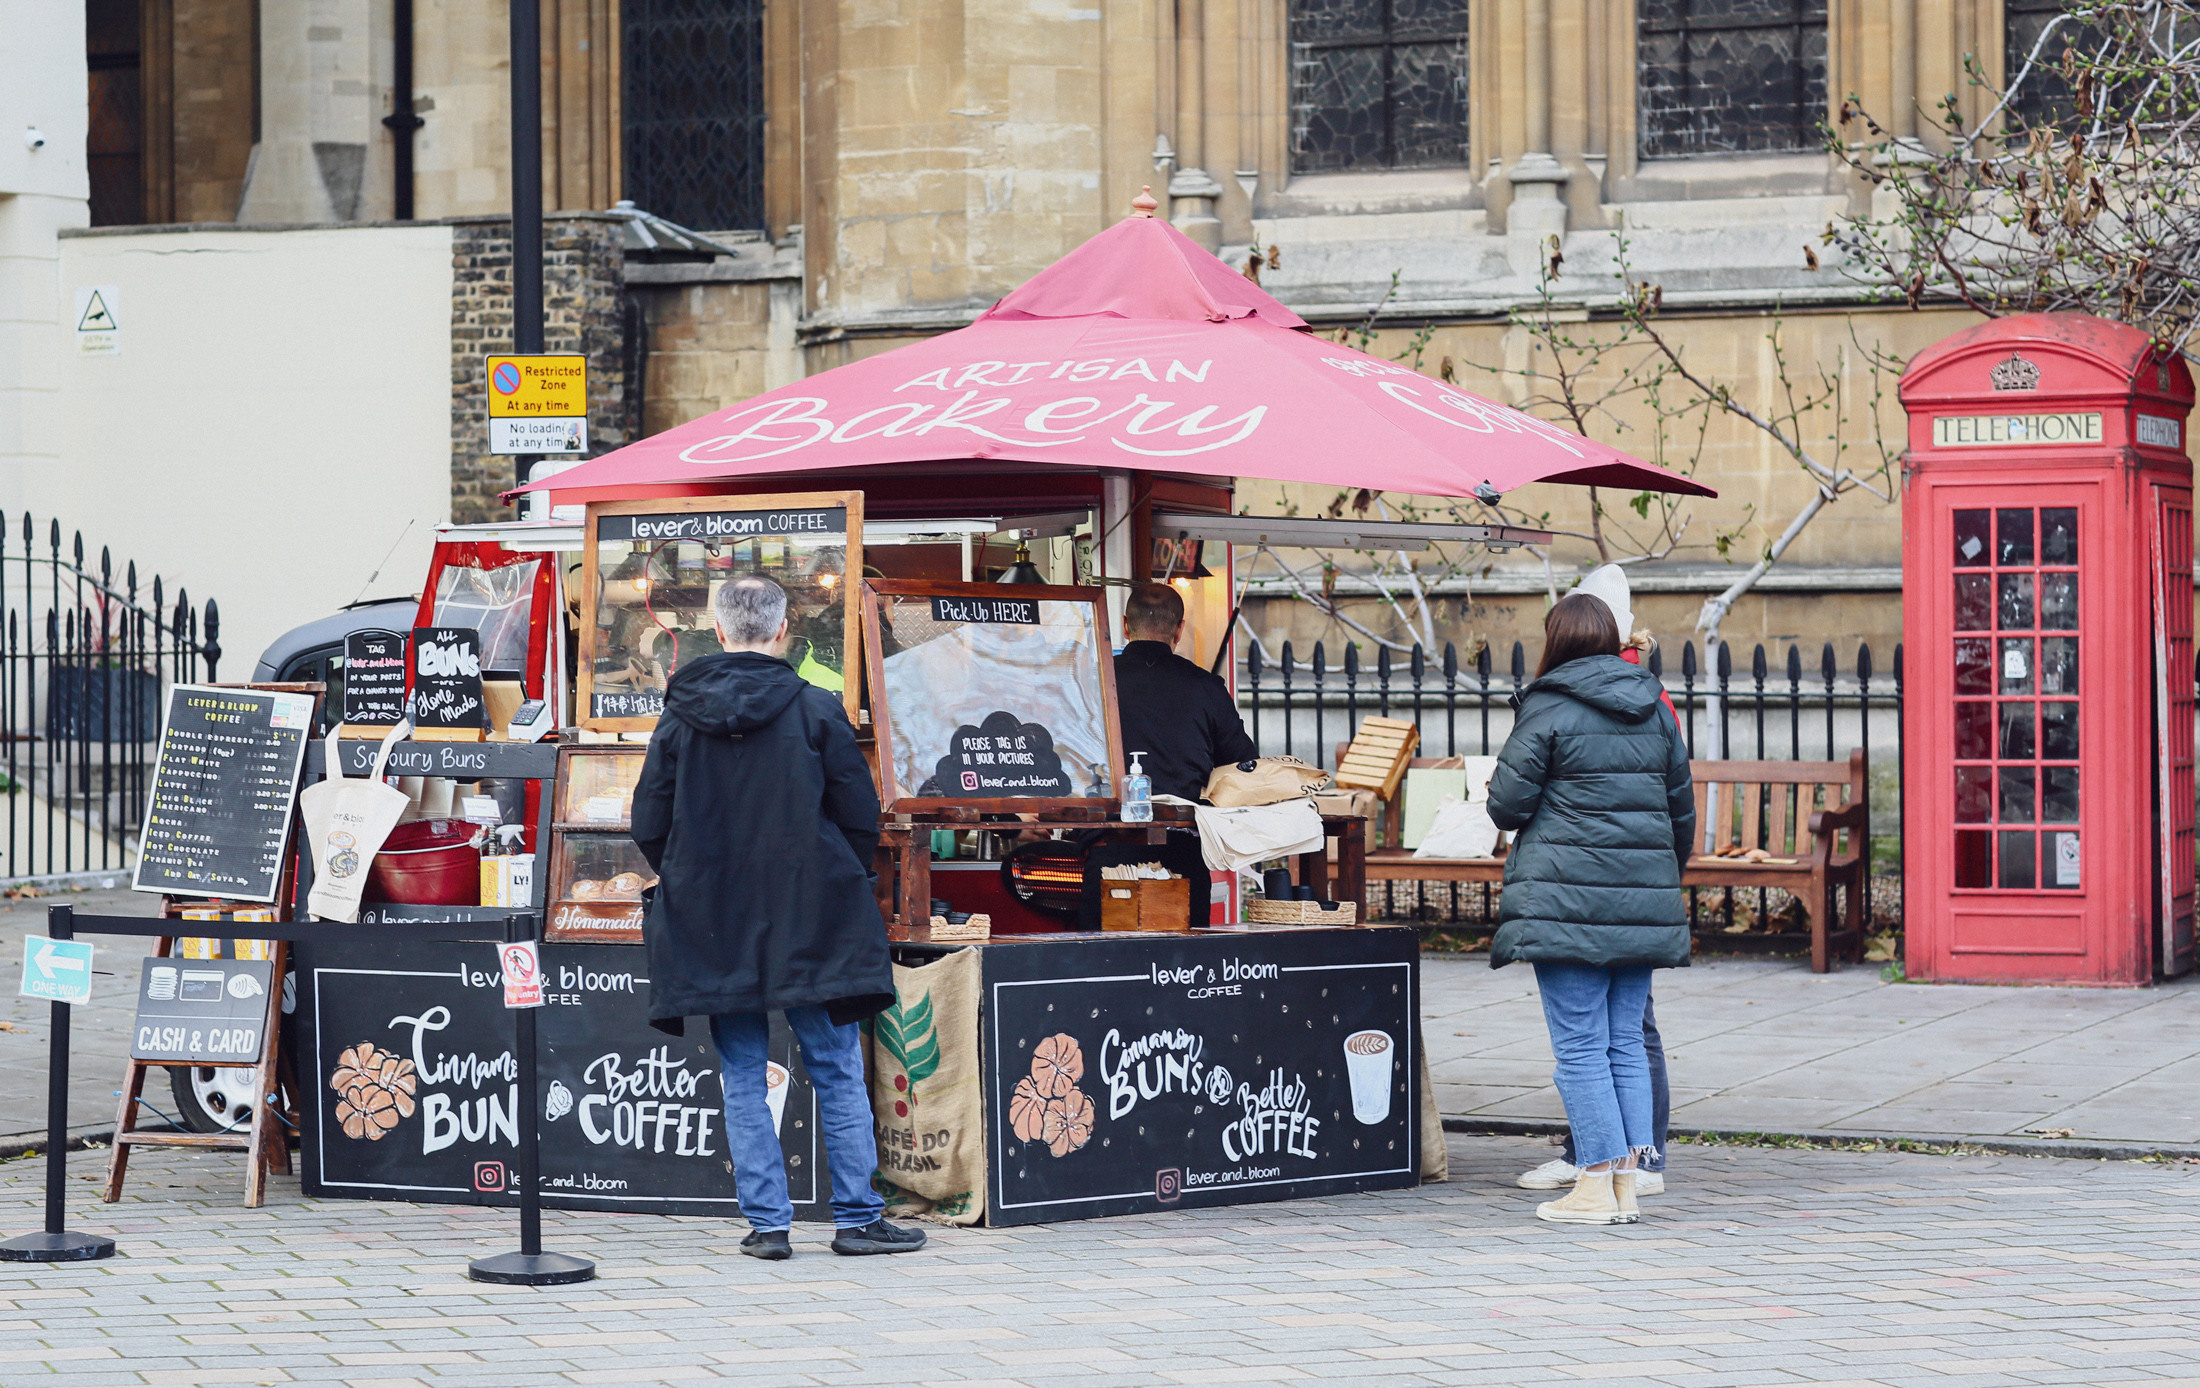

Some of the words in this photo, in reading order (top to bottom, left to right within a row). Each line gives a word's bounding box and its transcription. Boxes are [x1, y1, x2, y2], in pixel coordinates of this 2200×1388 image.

[525, 366, 581, 376] Restricted
[893, 358, 1212, 392] ARTISAN
[541, 380, 566, 390] Zone
[507, 401, 520, 411] At
[524, 403, 541, 412] any
[546, 401, 569, 411] time
[510, 424, 525, 433] No
[679, 390, 1268, 463] Bakery
[1938, 414, 2099, 442] TELEPHONE
[2137, 417, 2179, 446] TELEPHONE
[509, 438, 520, 447] at
[524, 439, 541, 449] any
[546, 438, 565, 447] tim
[632, 517, 692, 537] lever
[691, 517, 703, 536] &
[706, 515, 763, 535] bloom
[768, 513, 827, 531] COFFEE
[993, 602, 1032, 623] HERE
[436, 631, 458, 642] ALL
[366, 645, 386, 654] TAG
[380, 673, 401, 681] POSTS
[187, 698, 217, 709] LEVER
[227, 701, 259, 712] BLOOM
[417, 689, 455, 717] Home
[440, 694, 478, 722] Made
[205, 712, 241, 724] COFFEE
[963, 737, 991, 750] PLEASE
[995, 737, 1011, 750] TAG
[1015, 736, 1027, 749] US
[163, 753, 186, 764] FLAT
[354, 745, 433, 772] Saoury
[441, 748, 486, 769] Buns
[976, 753, 996, 765] YOUR
[998, 753, 1034, 766] PICTURES
[158, 778, 187, 789] LATTE
[514, 876, 529, 885] LY!
[555, 905, 643, 930] Homemade
[461, 962, 504, 988] lev
[560, 965, 634, 993] bloom
[1152, 962, 1204, 986] lever
[1207, 968, 1216, 984] &
[1223, 957, 1279, 981] bloom
[32, 980, 57, 994] ONE
[518, 990, 539, 999] entry
[1187, 985, 1242, 999] COFFEE
[138, 1026, 187, 1052] CASH
[189, 1031, 202, 1053] &
[207, 1028, 256, 1054] CARD
[388, 1006, 518, 1090] Cinnam
[1100, 1028, 1203, 1085] Cinnamon
[584, 1045, 713, 1104] Better
[1236, 1067, 1311, 1131] Better
[423, 1084, 530, 1155] BUN
[579, 1094, 720, 1156] COFFEE
[881, 1125, 913, 1151] AFÉ
[922, 1129, 950, 1152] DO
[1222, 1110, 1321, 1162] COFFEE
[883, 1146, 941, 1173] BRASIL
[510, 1170, 628, 1190] ler_and_bloom
[1186, 1166, 1280, 1186] lever_and_bloom
